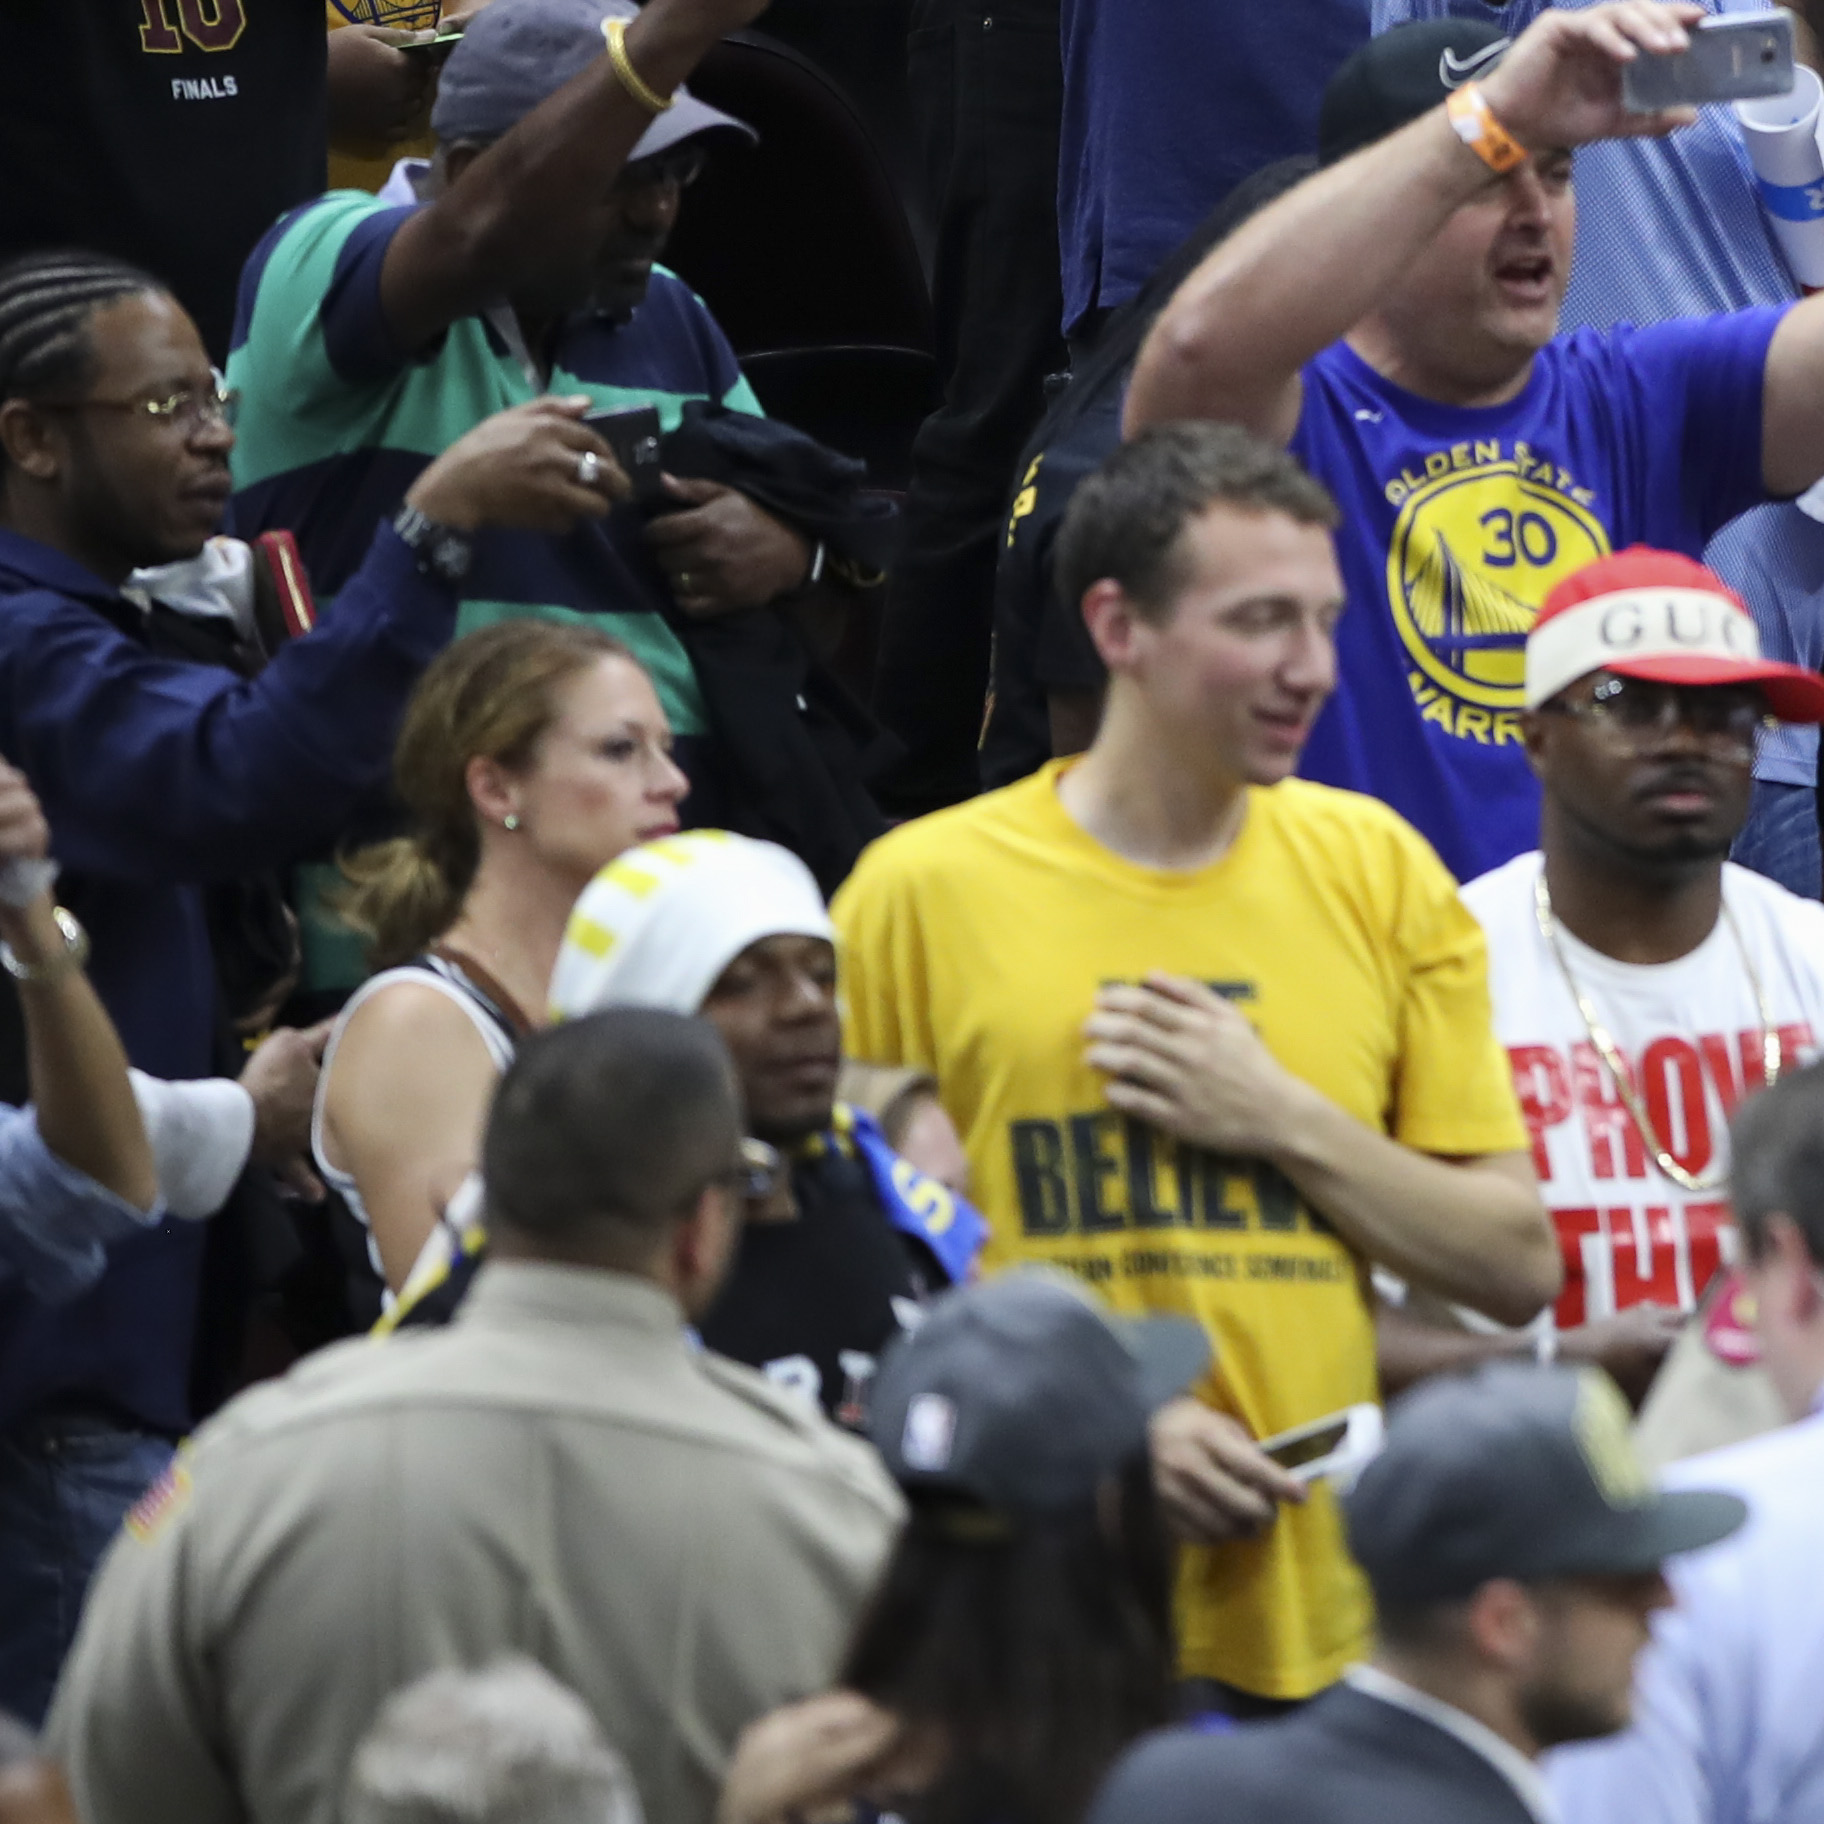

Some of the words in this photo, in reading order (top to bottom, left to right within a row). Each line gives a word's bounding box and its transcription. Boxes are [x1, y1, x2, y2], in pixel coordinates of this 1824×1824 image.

[171, 75, 238, 100] FINALS
[1480, 508, 1557, 567] 30
[1408, 670, 1527, 747] WARR
[1008, 1104, 1338, 1237] BELIEV
